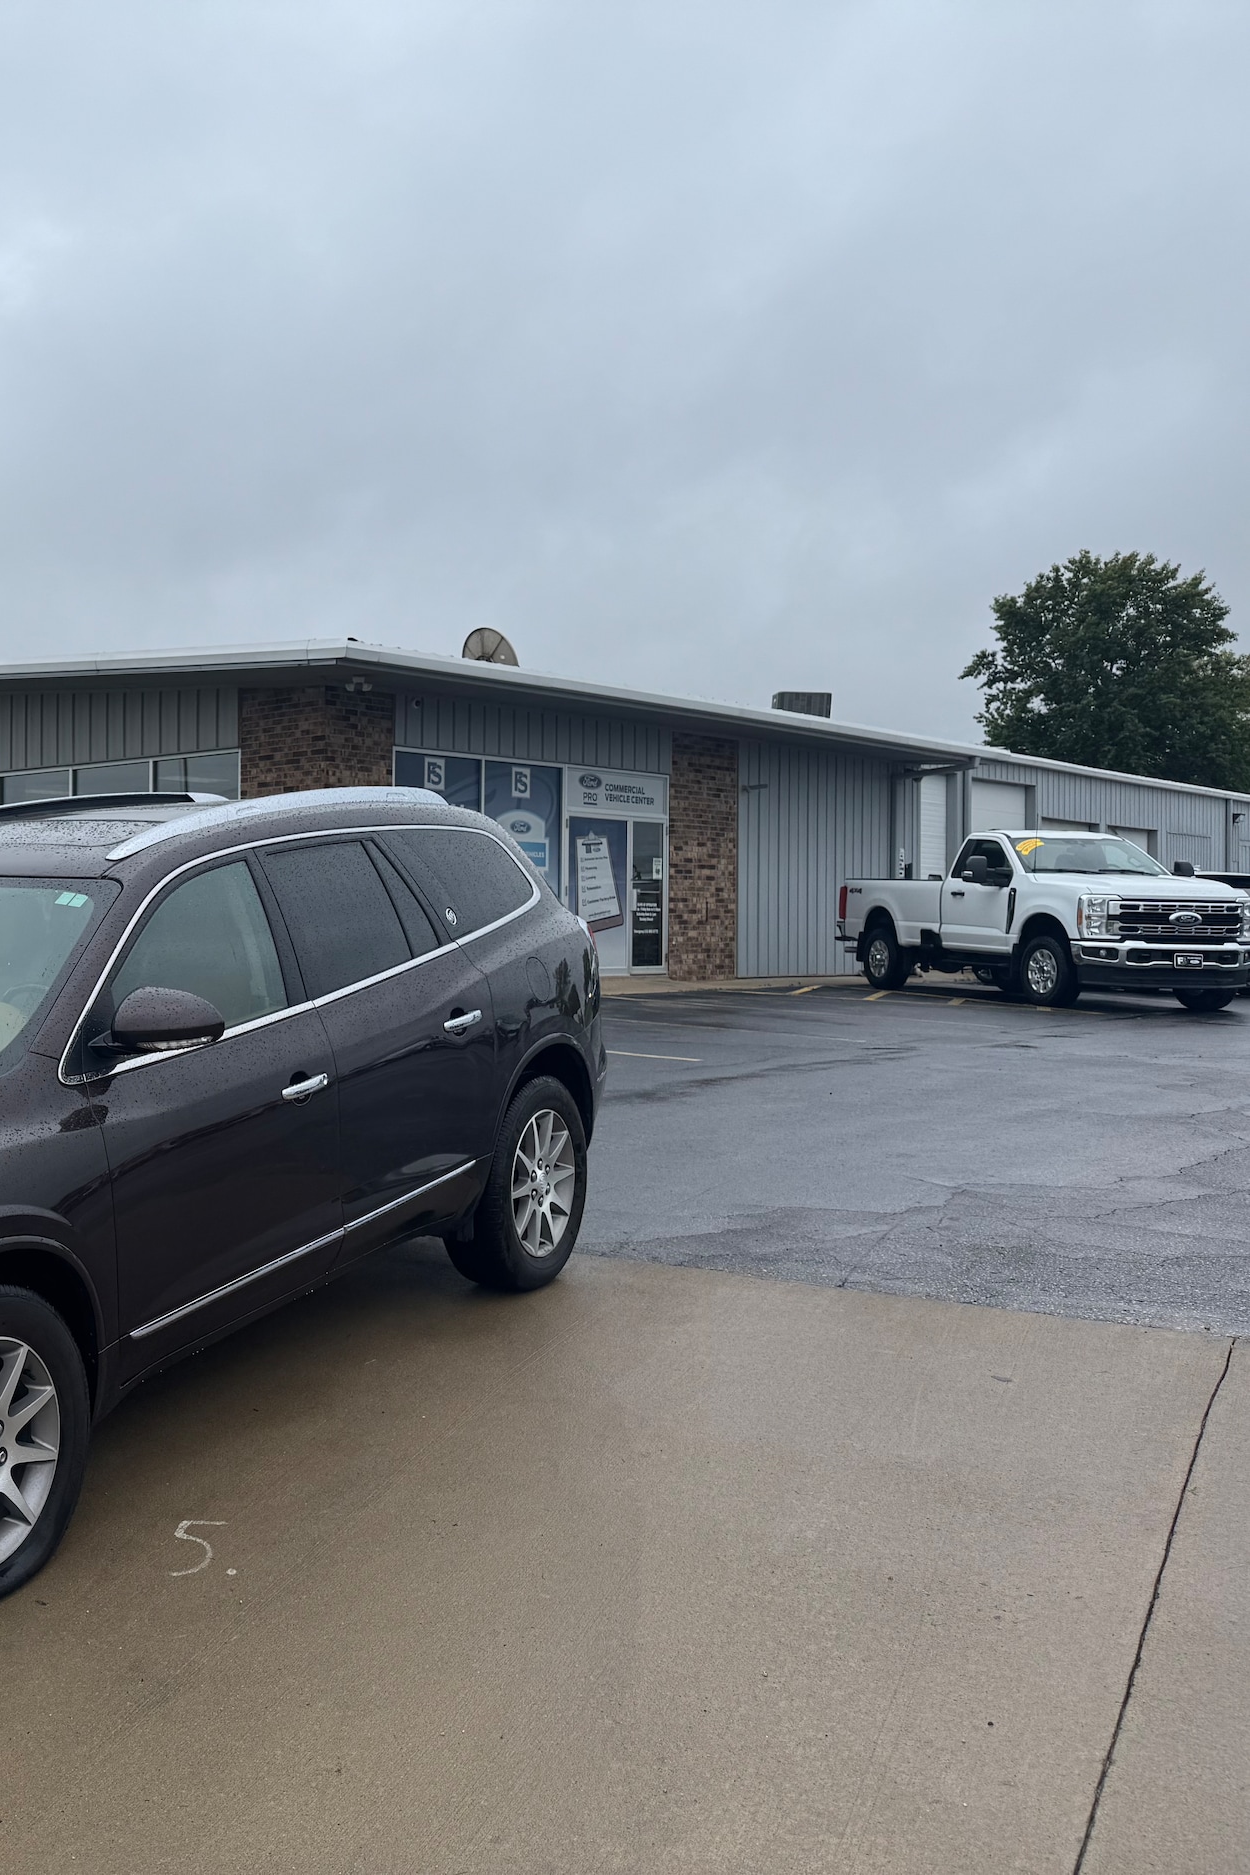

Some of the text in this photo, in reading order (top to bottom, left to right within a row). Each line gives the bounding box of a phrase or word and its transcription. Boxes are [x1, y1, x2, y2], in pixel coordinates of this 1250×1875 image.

[582, 775, 599, 787] Ford
[604, 783, 645, 795] COMMERCIAL
[583, 792, 598, 802] PRO
[604, 793, 655, 806] VEHICLE CENTER
